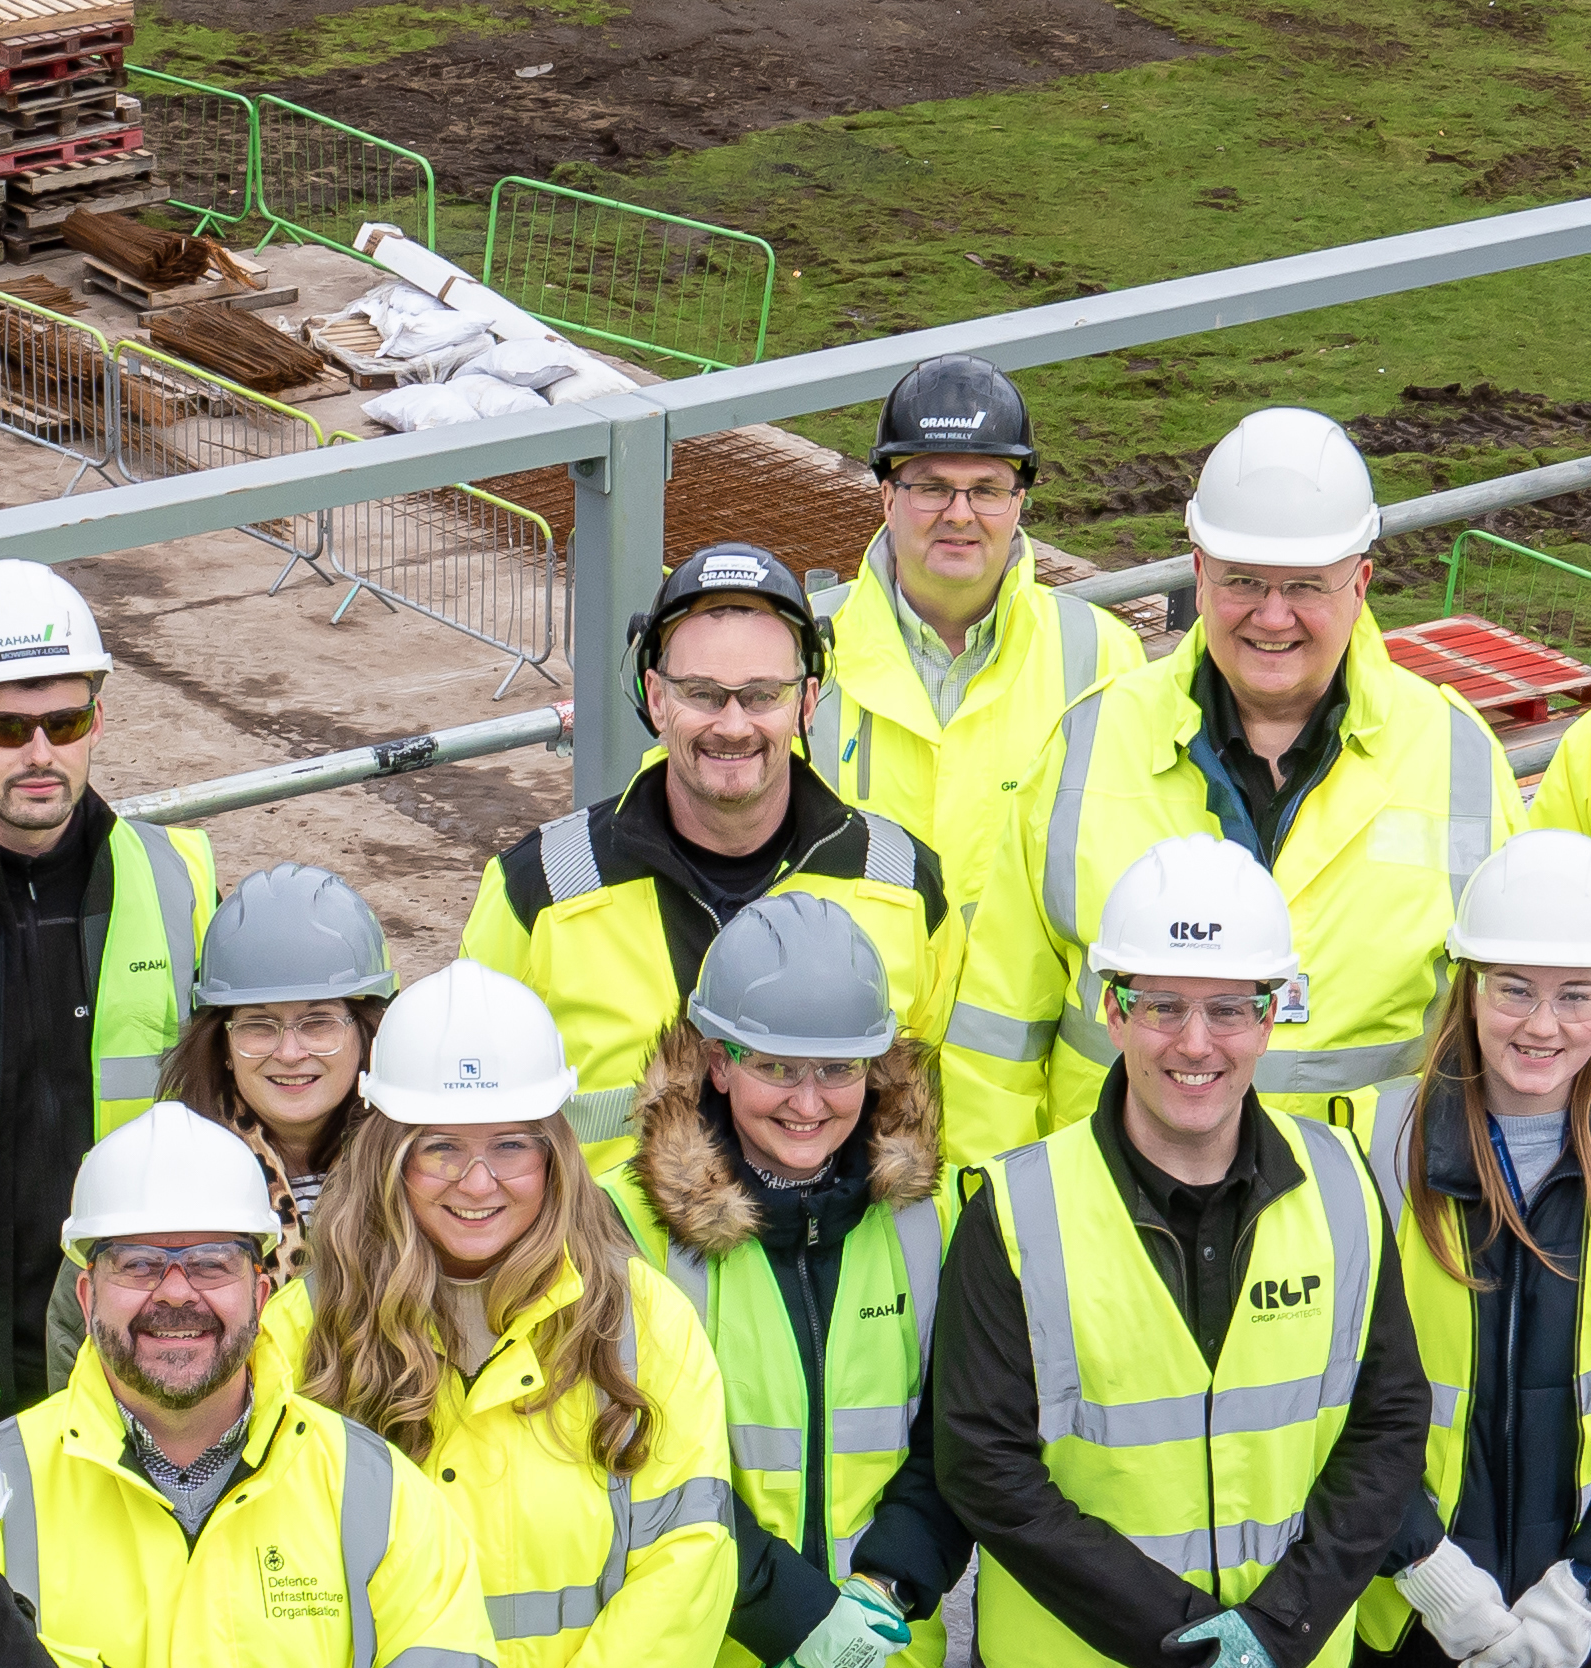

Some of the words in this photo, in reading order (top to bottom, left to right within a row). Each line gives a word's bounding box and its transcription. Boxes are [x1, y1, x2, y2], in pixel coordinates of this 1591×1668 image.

[919, 417, 972, 429] GRAHAM
[698, 571, 755, 582] GRAHAM
[443, 1082, 473, 1090] TETRA
[475, 1081, 499, 1089] TECH
[1251, 1313, 1276, 1324] CRGP
[1276, 1307, 1322, 1322] ARCHITECTS
[268, 1576, 318, 1588] Defence
[270, 1591, 344, 1603] Infrastructure
[272, 1605, 340, 1620] Organisation
